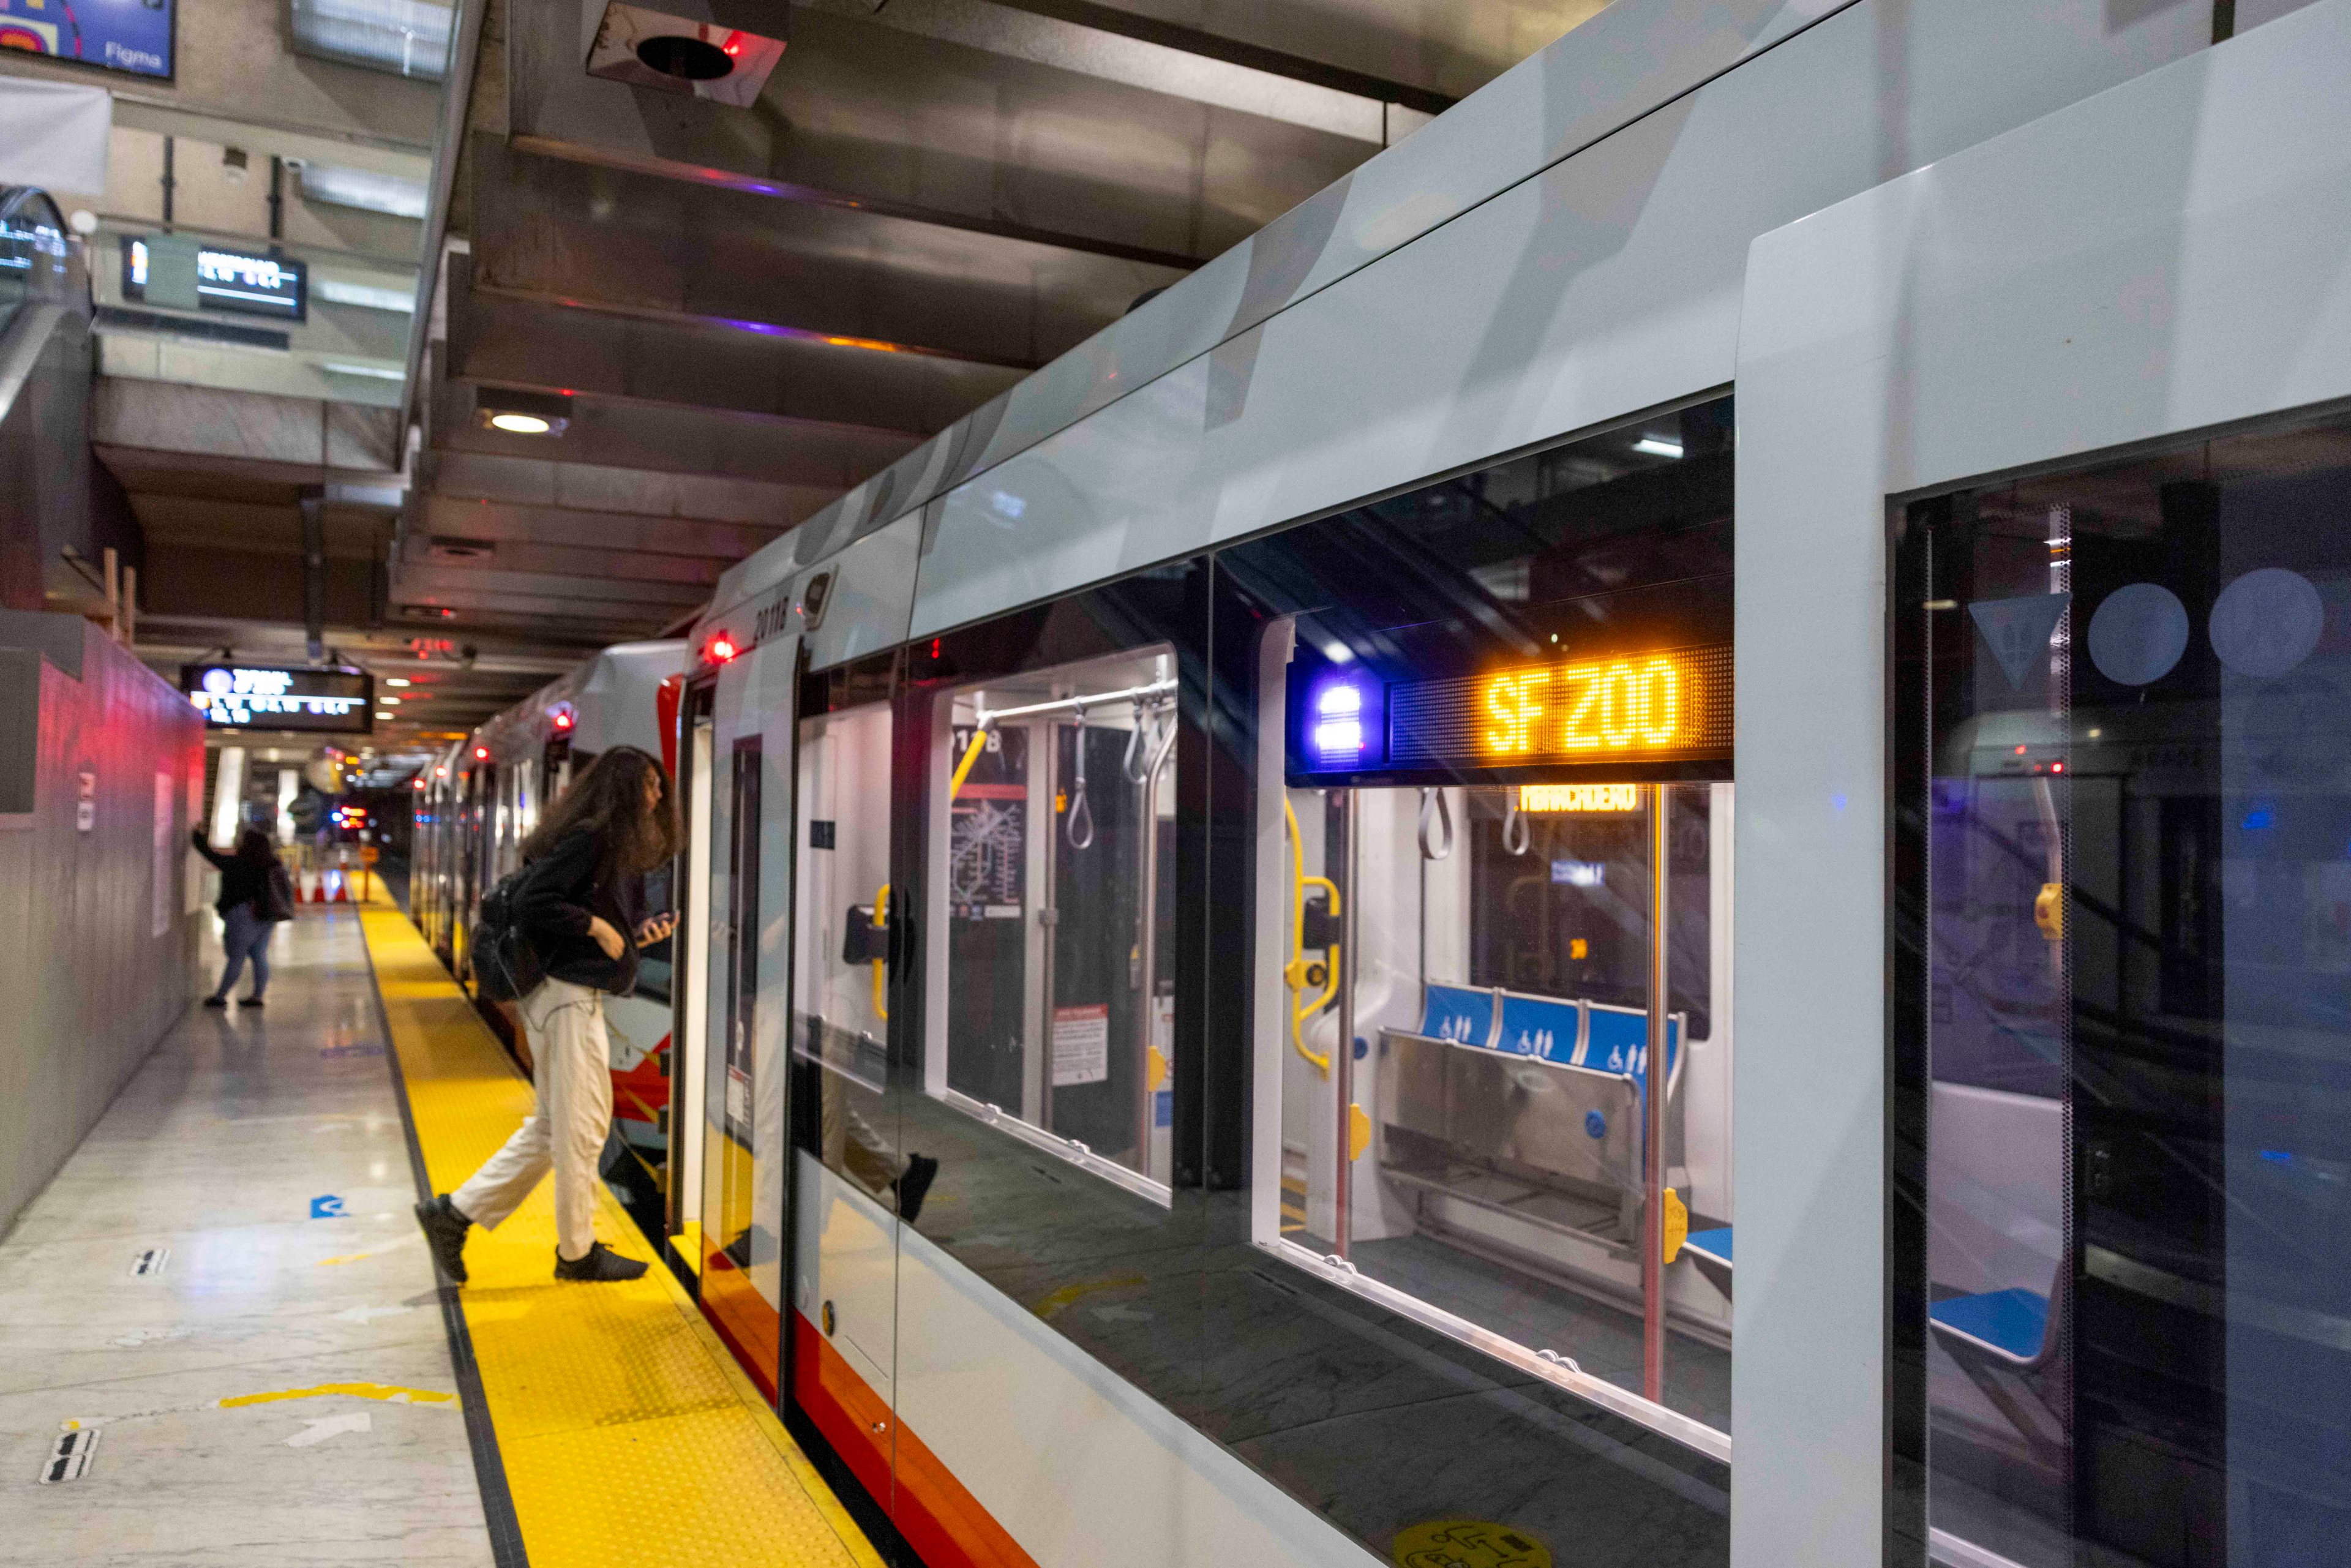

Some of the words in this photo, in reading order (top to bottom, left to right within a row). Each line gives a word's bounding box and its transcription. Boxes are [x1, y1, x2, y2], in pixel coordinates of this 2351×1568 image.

[105, 41, 163, 69] Figma
[1487, 672, 1550, 751] SF
[1565, 658, 1678, 748] ZOO
